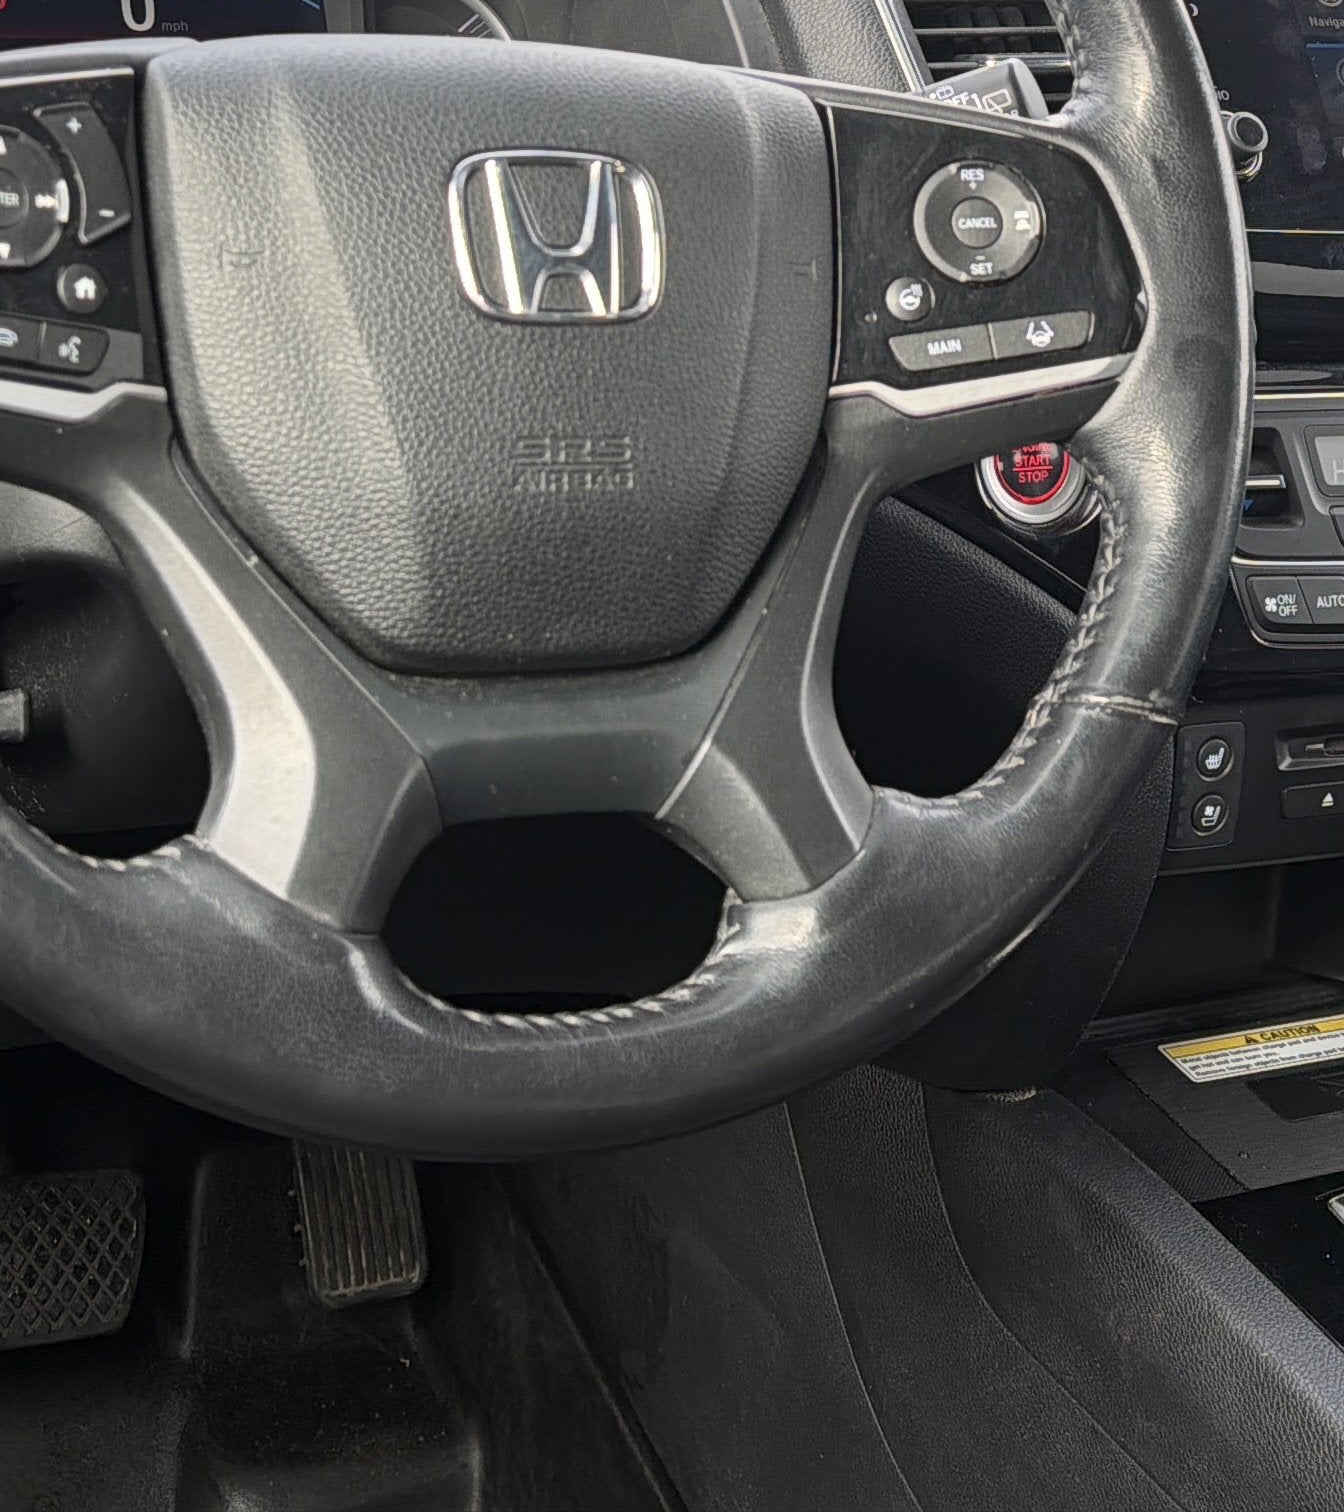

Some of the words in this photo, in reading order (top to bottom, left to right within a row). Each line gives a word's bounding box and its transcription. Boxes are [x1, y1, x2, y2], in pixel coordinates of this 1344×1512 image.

[161, 21, 189, 33] mph
[960, 168, 985, 181] RES
[958, 216, 998, 229] CANCEL
[970, 262, 993, 275] SET
[927, 339, 962, 355] MAIN
[1015, 453, 1051, 467] START
[1018, 470, 1049, 484] STOP
[1277, 594, 1297, 606] ON/
[1278, 605, 1299, 617] OFF
[1260, 1023, 1320, 1041] CAUTION
